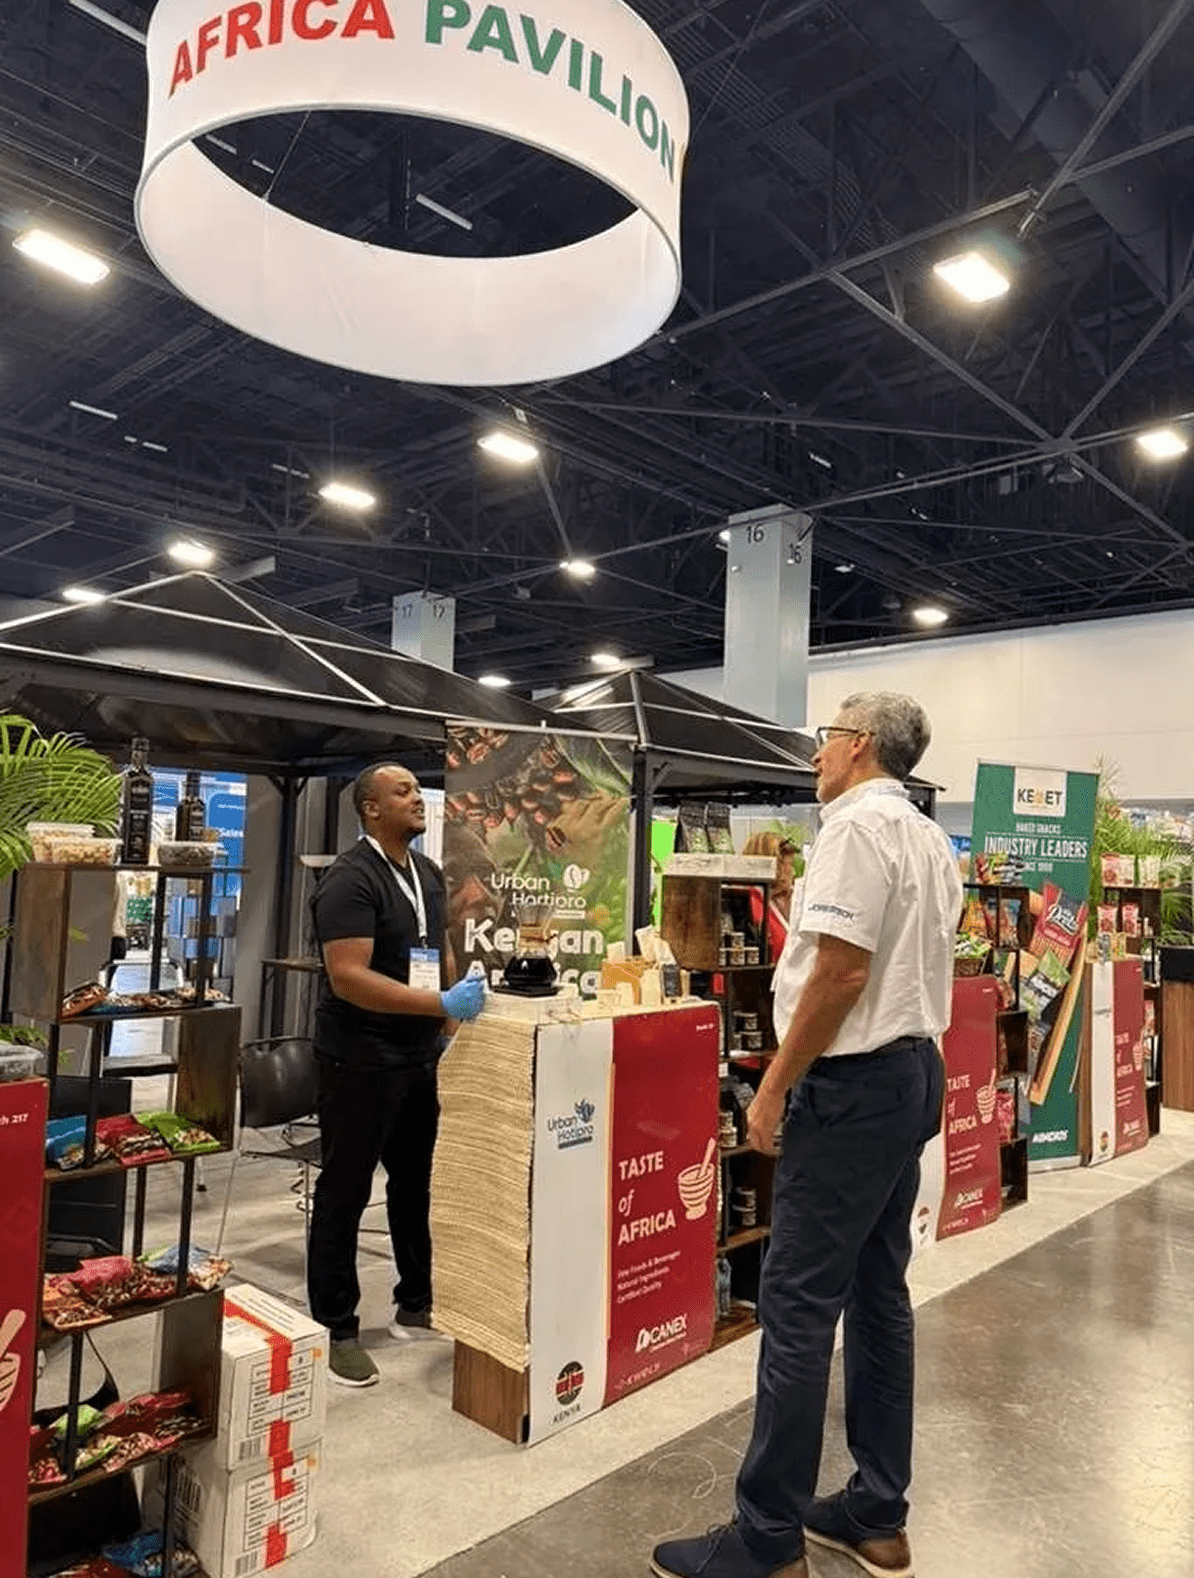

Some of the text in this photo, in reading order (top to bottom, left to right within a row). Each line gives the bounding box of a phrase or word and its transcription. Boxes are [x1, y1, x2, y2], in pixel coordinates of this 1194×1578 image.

[168, 0, 678, 185] AFRICA PAVILION
[747, 523, 764, 543] 16
[984, 835, 1088, 859] INDUSTRY LEADERS
[491, 872, 550, 890] Urban
[511, 892, 587, 910] Hortipro
[464, 917, 604, 961] Keyan
[466, 960, 598, 995] Arica
[547, 1112, 577, 1132] Urban
[618, 1150, 664, 1181] TASTE
[618, 1189, 635, 1216] of
[617, 1209, 677, 1246] AFRICA
[649, 1313, 688, 1343] CANEX
[553, 1404, 582, 1424] KENYA
